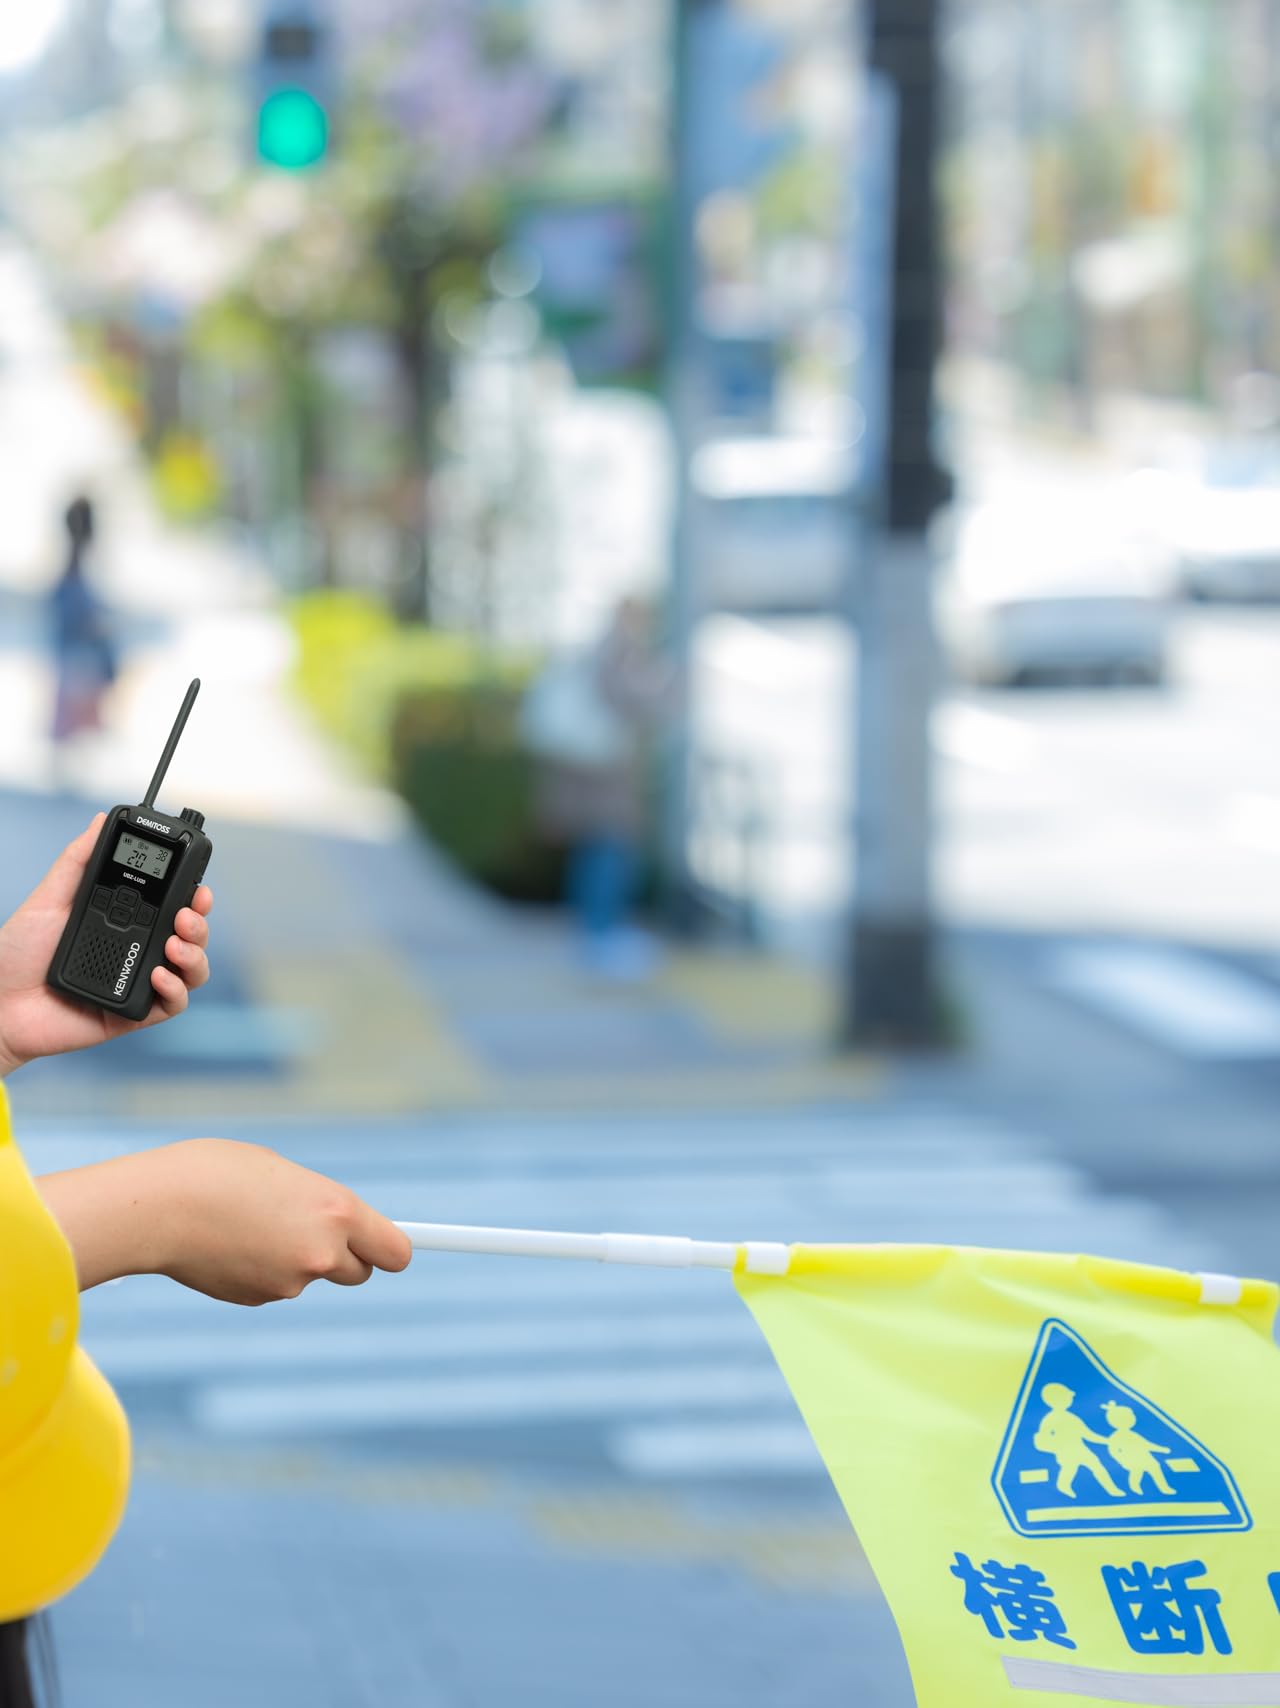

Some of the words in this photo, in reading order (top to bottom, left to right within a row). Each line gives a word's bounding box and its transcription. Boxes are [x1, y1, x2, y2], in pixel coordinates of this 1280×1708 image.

[136, 816, 171, 834] DEMITOSS
[126, 849, 148, 869] 20
[113, 942, 141, 997] KENWOOD
[949, 1551, 1280, 1655] 横断
